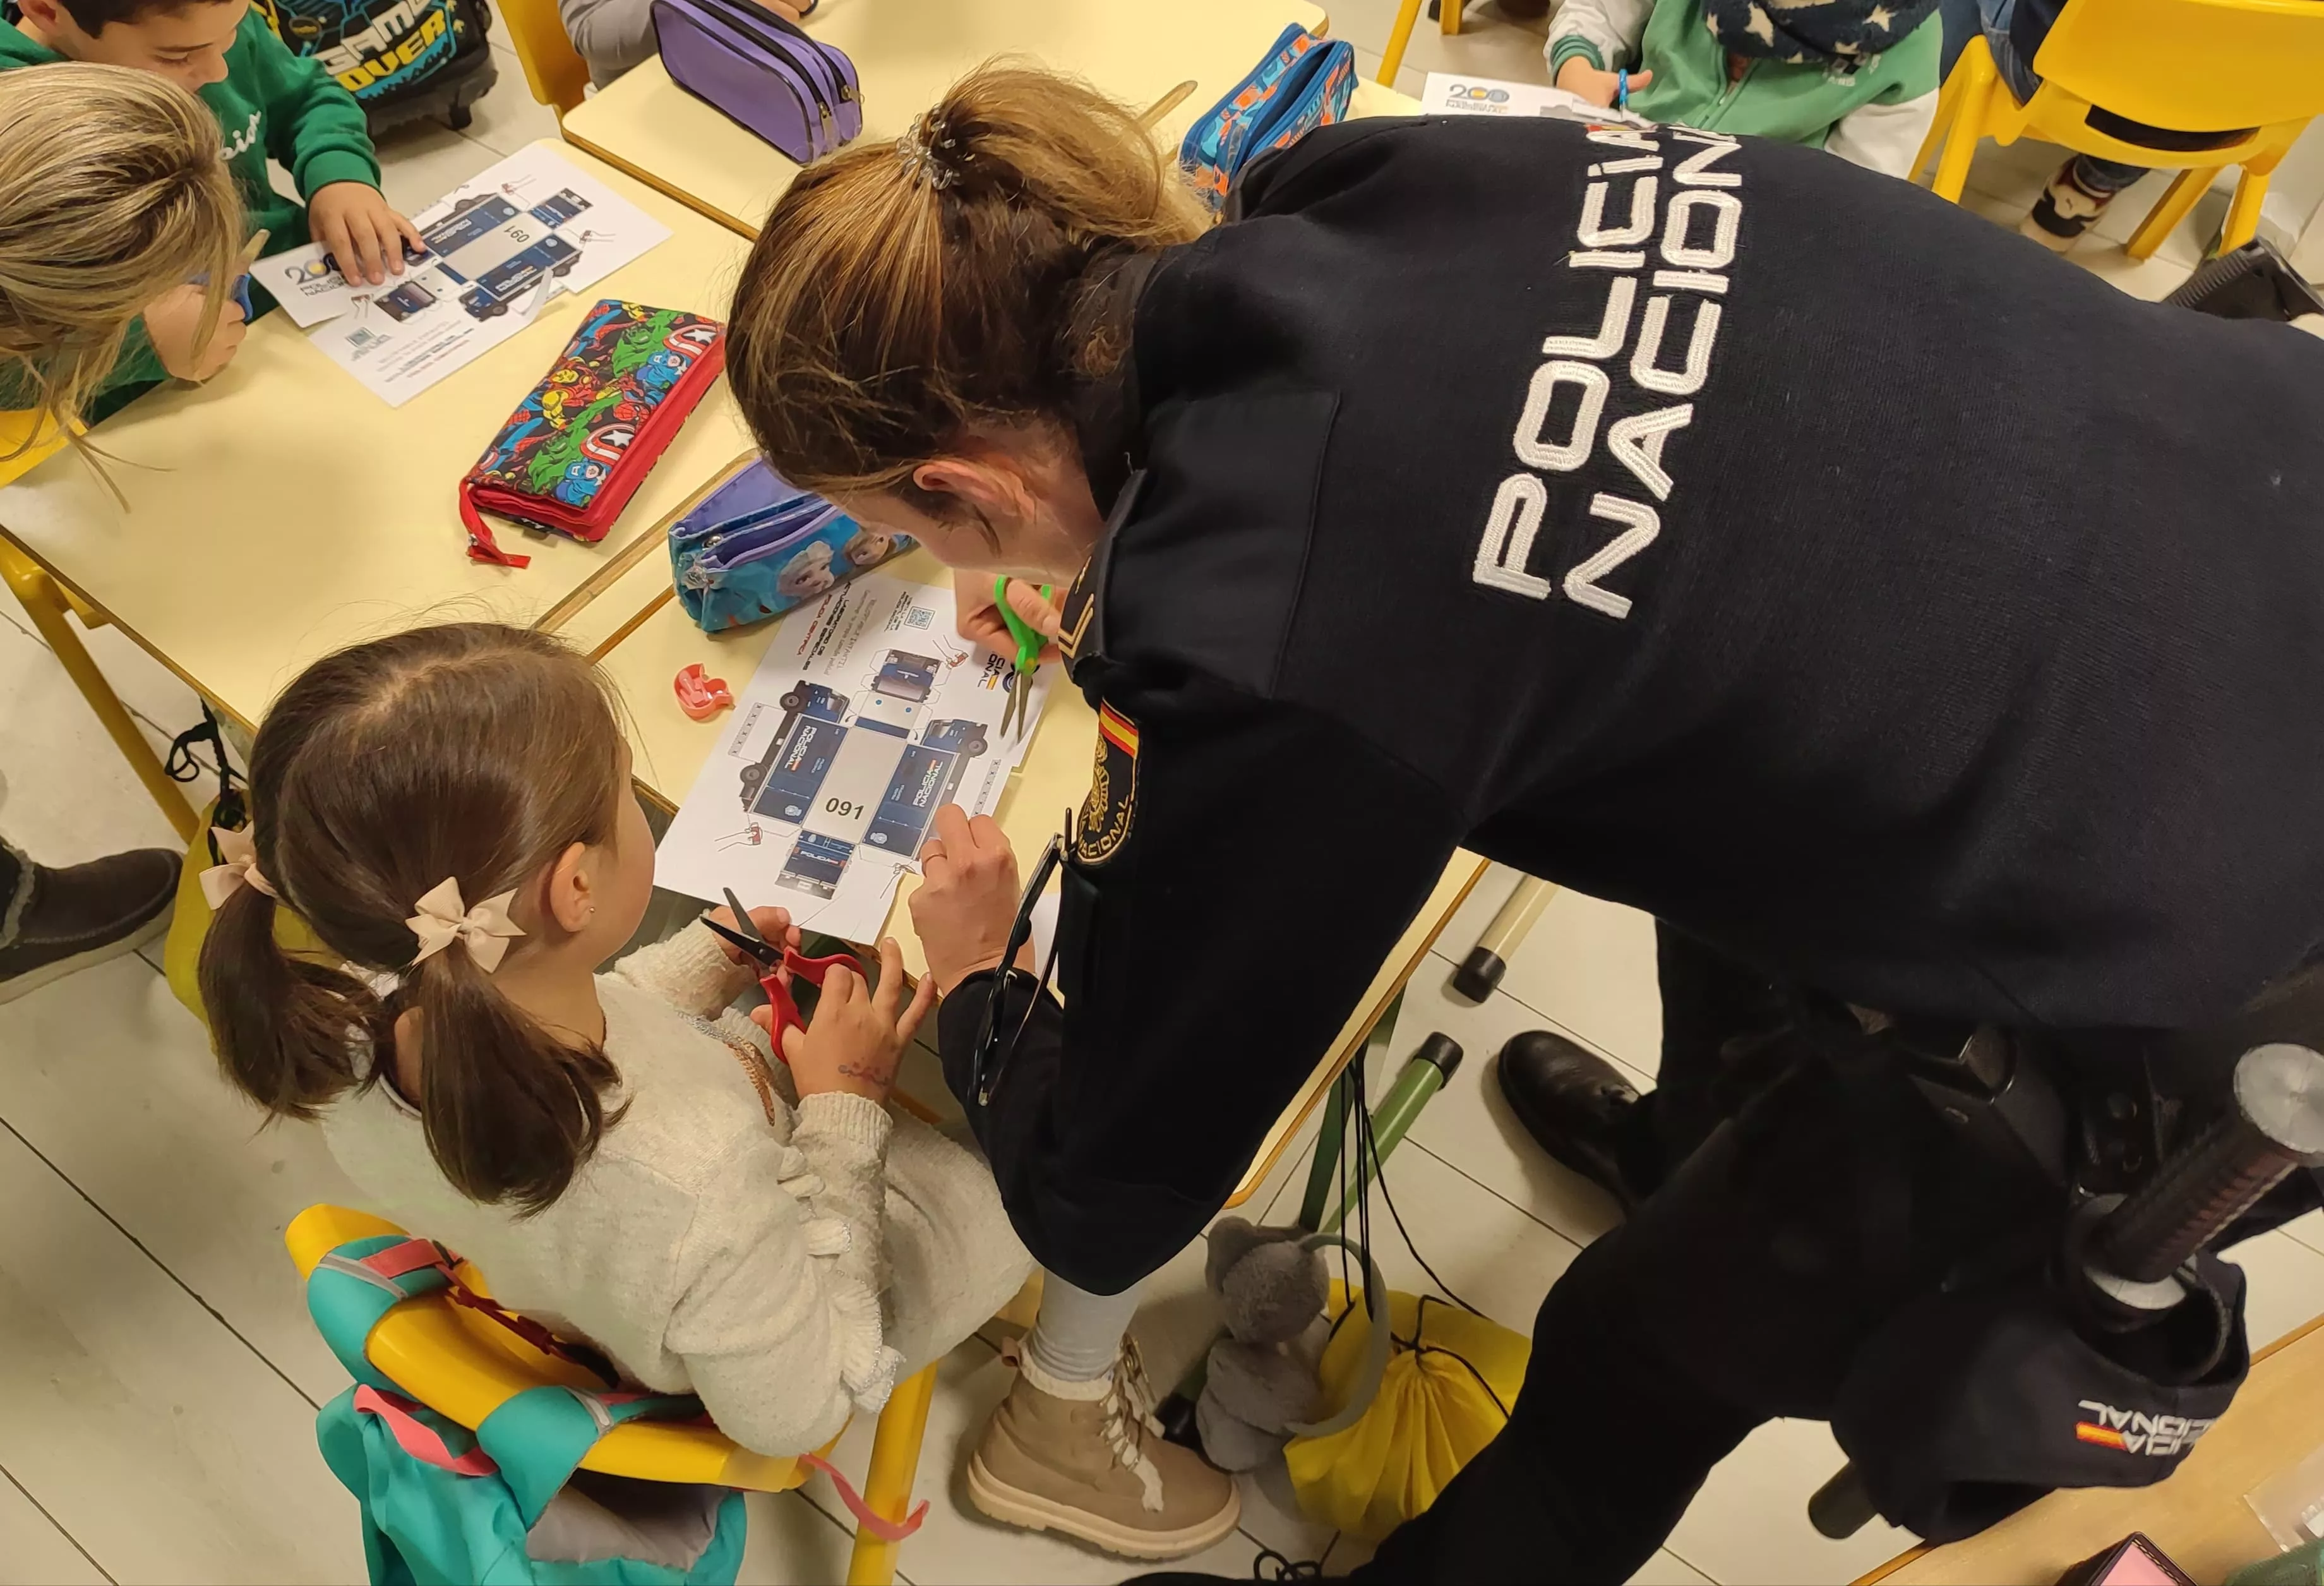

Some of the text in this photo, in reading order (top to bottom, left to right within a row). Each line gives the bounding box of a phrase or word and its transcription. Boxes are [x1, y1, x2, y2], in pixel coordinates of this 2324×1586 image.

[335, 9, 446, 92] OVER
[503, 225, 529, 244] 091
[1473, 128, 1663, 601] POLICÍA
[1562, 126, 1742, 620] NACION
[977, 653, 998, 688] ONAL
[784, 725, 811, 769] NACIONAL
[797, 727, 818, 761] POLICIA
[913, 769, 933, 806] POLICIA
[919, 760, 943, 807] NACIONAL
[825, 798, 865, 820] 091
[800, 850, 831, 863] POLICIA
